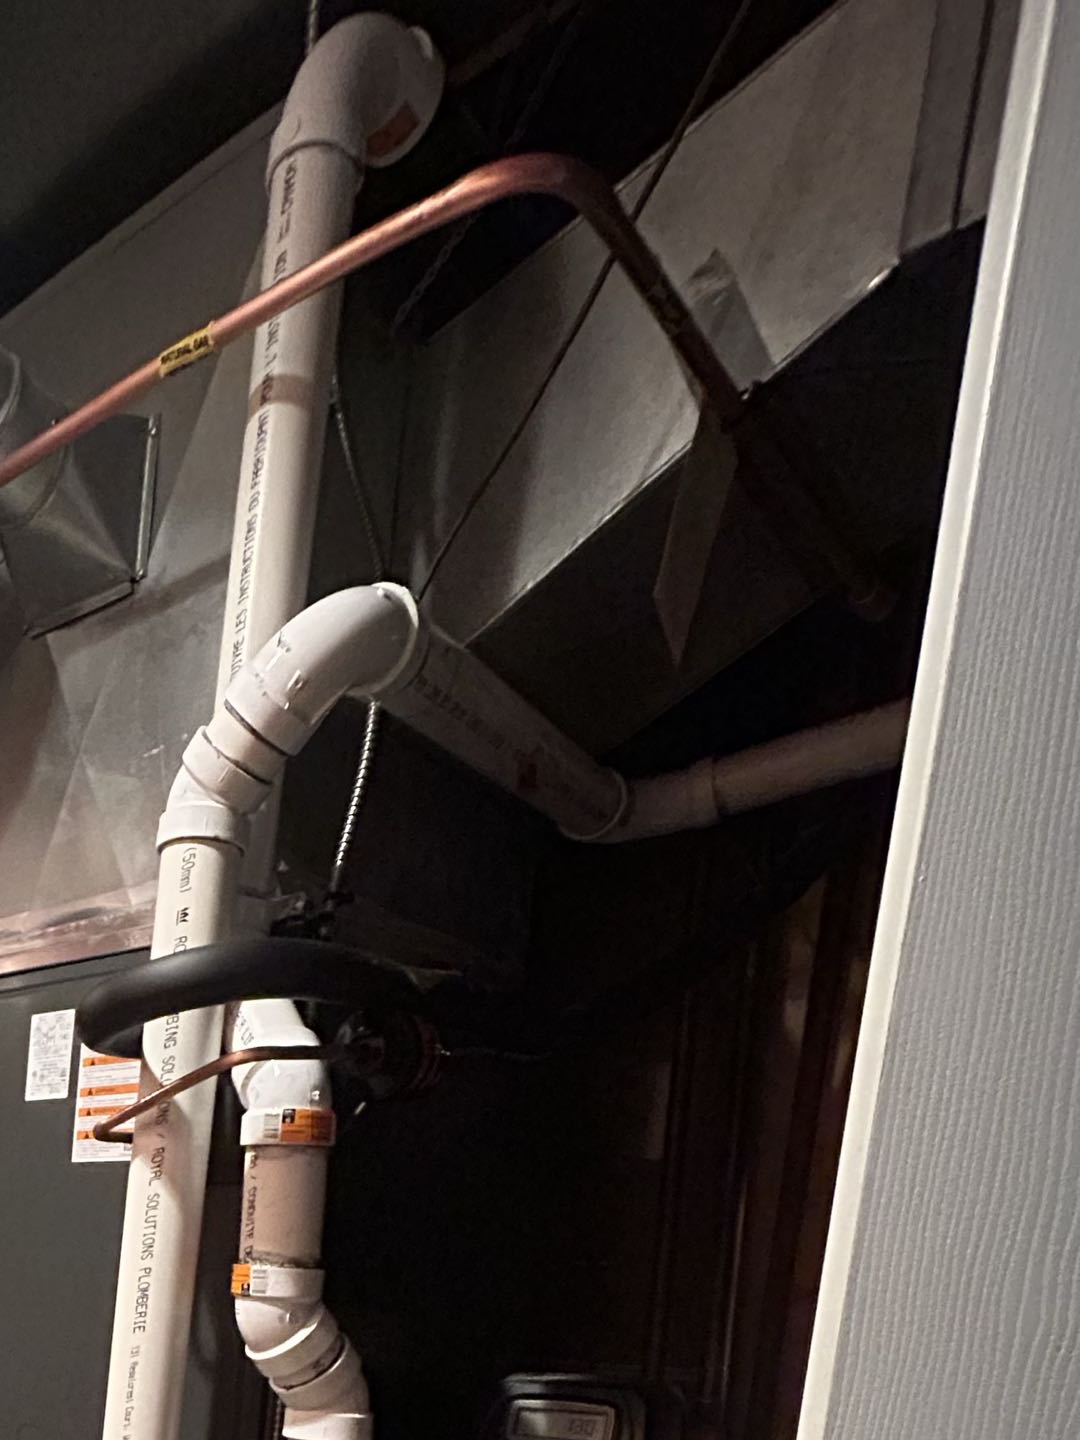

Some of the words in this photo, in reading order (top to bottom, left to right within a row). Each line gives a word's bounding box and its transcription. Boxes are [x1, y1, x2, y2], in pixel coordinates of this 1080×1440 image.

[235, 608, 248, 634] LES
[179, 847, 196, 893] (50mm)
[149, 1147, 165, 1187] ROYAL
[140, 1193, 160, 1261] SOLUTIONS
[132, 1267, 152, 1334] PLOMBERIE
